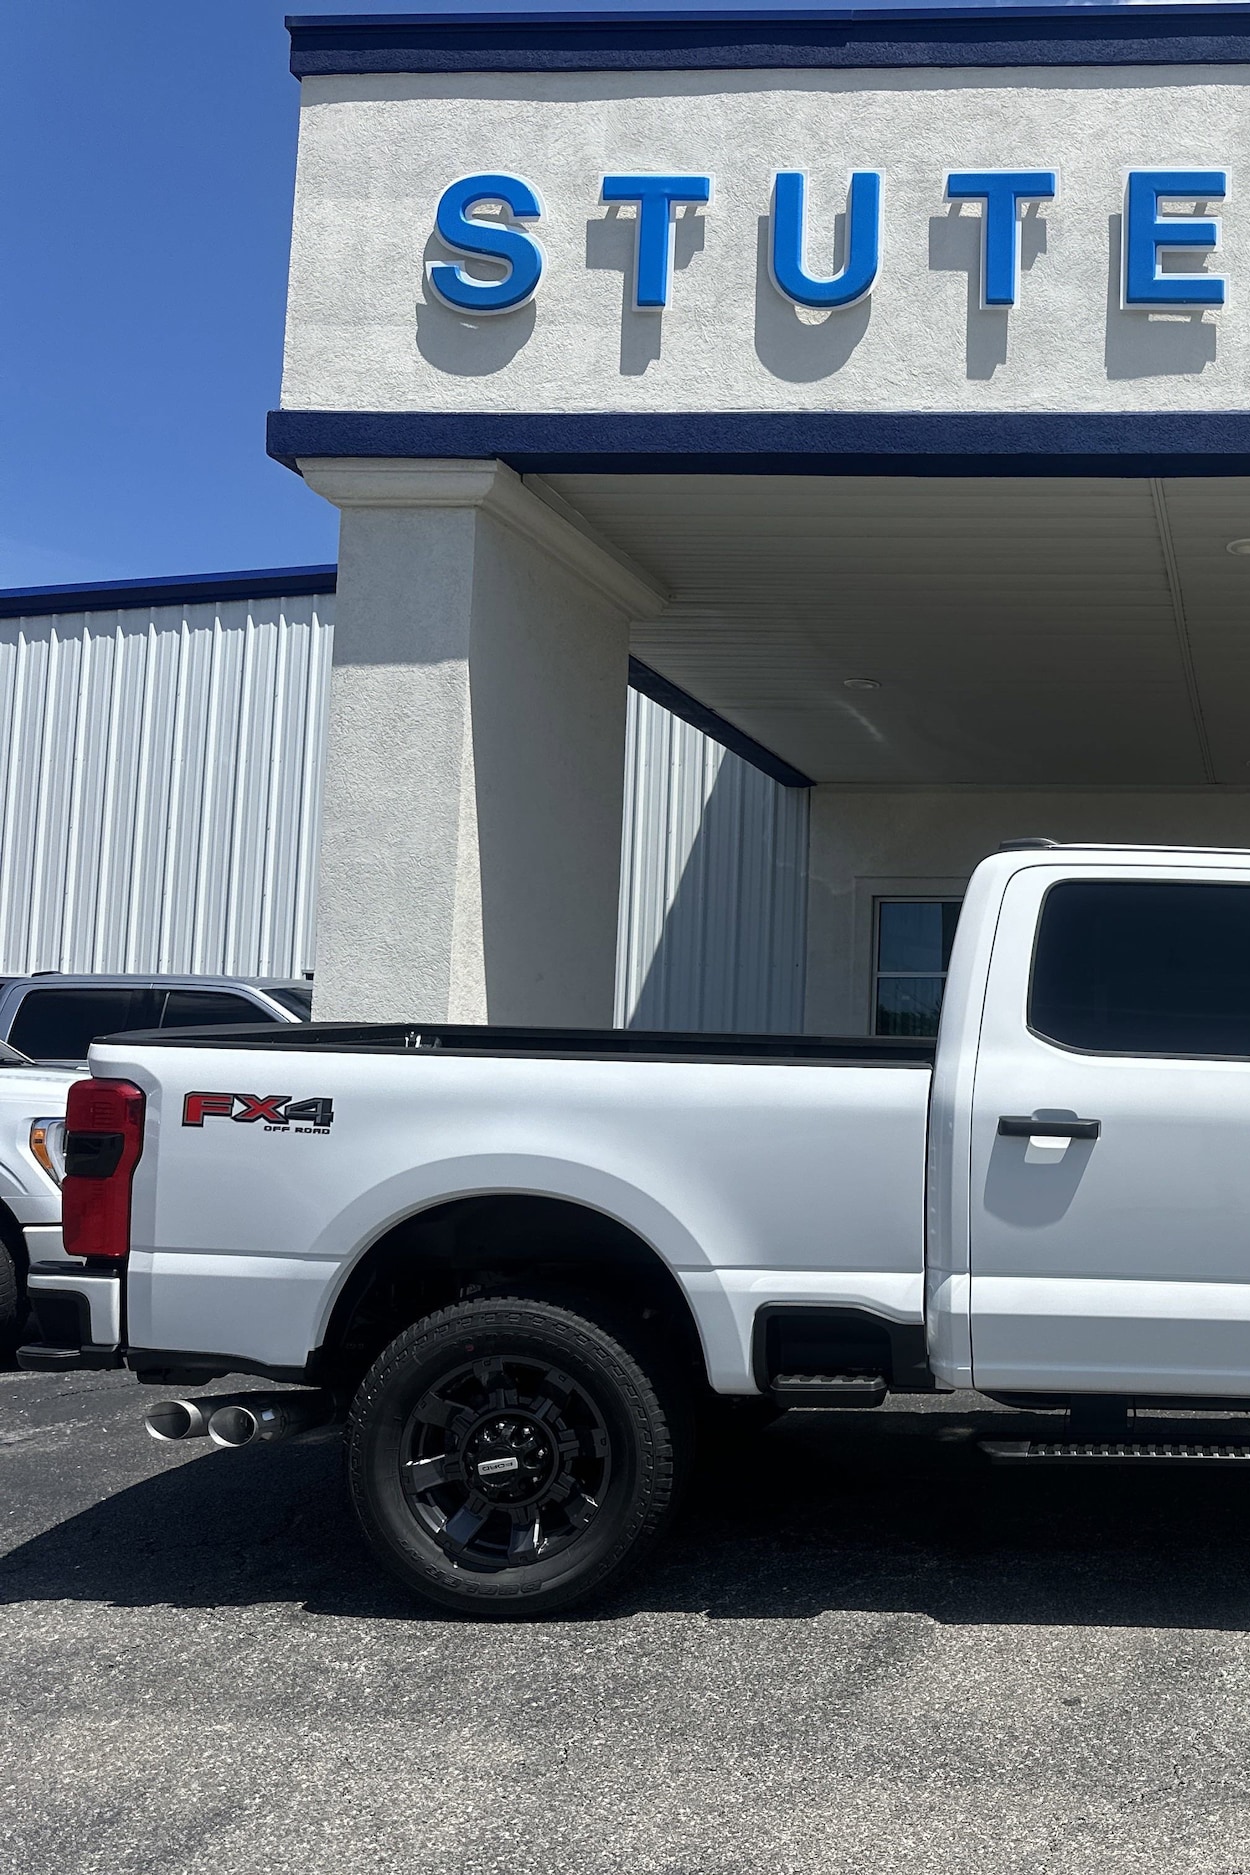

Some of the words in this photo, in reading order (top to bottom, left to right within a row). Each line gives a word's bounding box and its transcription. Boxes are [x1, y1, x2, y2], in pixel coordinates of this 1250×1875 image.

[182, 1091, 334, 1128] FX4
[263, 1125, 291, 1133] OFF
[294, 1127, 331, 1135] ROAD
